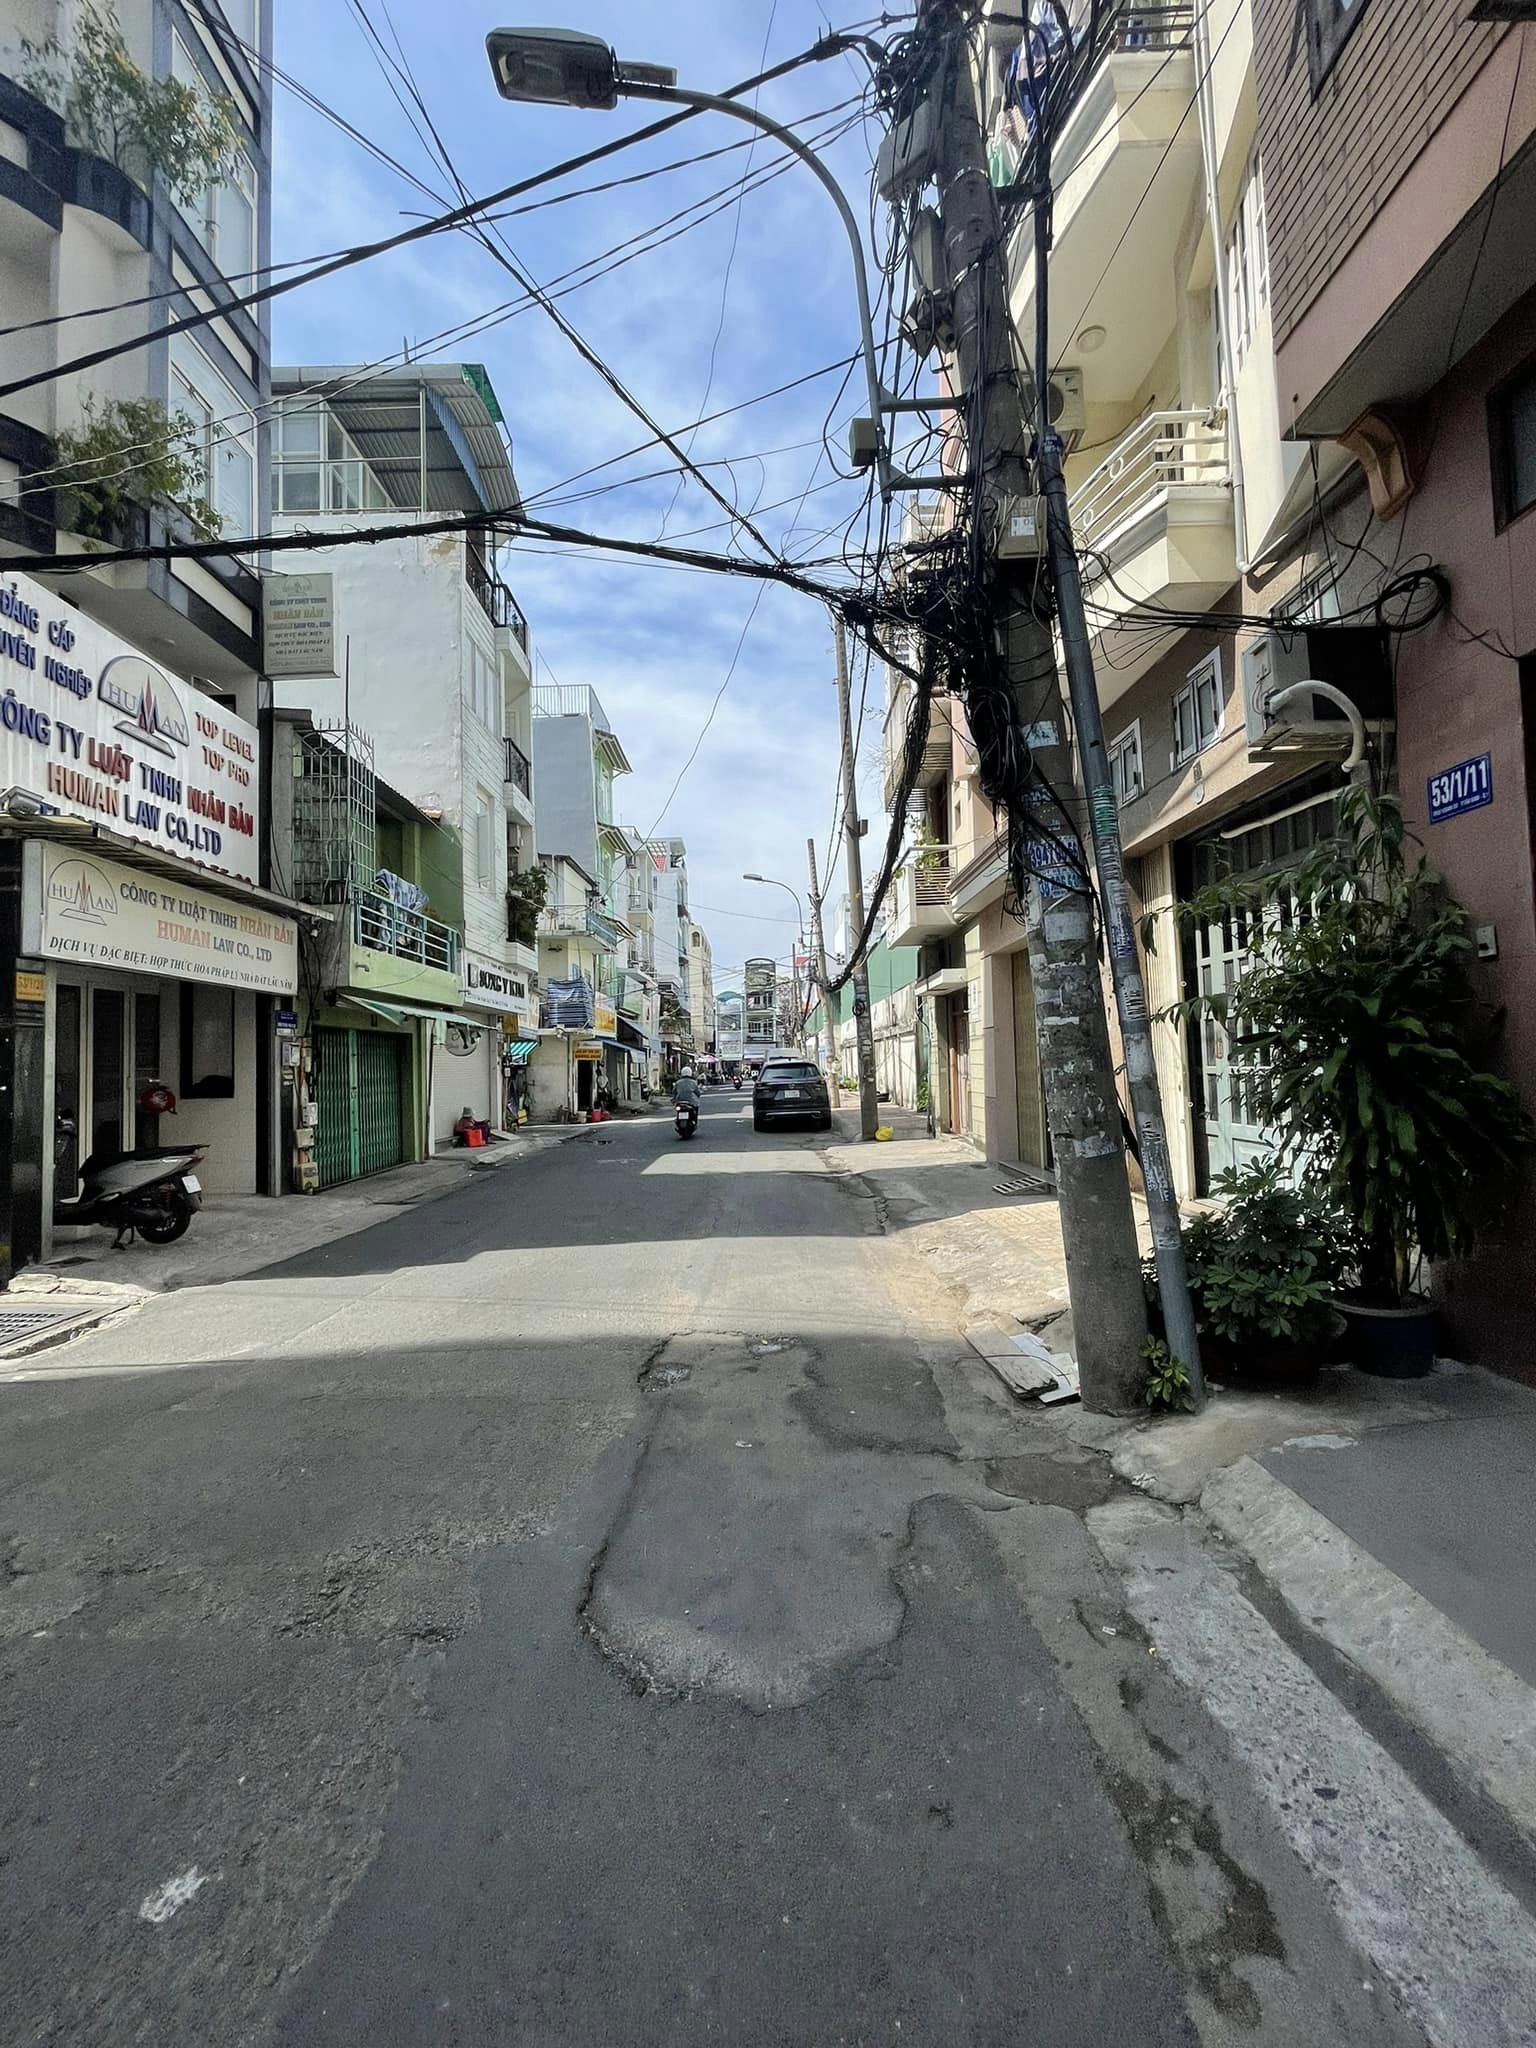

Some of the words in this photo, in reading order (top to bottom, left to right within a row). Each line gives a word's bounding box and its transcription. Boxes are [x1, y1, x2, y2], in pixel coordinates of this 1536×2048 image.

[49, 619, 76, 652] CẤP
[45, 655, 93, 700] NGHIỆP
[195, 711, 220, 740] TOP
[222, 728, 255, 763] LEVEL
[0, 689, 51, 746] ÔNG
[56, 720, 85, 760] TY
[87, 737, 134, 784] LUẬT
[139, 762, 183, 805] TNHH
[187, 785, 226, 824] NHÂN
[228, 802, 254, 837] BẢN
[201, 745, 225, 772] TOP
[228, 760, 250, 787] PRO
[1431, 760, 1488, 807] 53/1/11
[48, 762, 119, 817] HUMAN
[124, 794, 162, 832] LAW
[120, 881, 158, 907] CÔNG
[160, 894, 176, 913] TY
[179, 899, 207, 923] LUẬT
[209, 909, 237, 930] TNHH
[240, 915, 271, 940] NHÂN
[273, 923, 294, 945] BẢN
[49, 936, 80, 952] DỊCH
[82, 942, 99, 958] VỤ
[149, 955, 169, 968] HỢP
[157, 919, 211, 949] HUMAN
[213, 936, 235, 954] LAW
[256, 947, 272, 962] LTD
